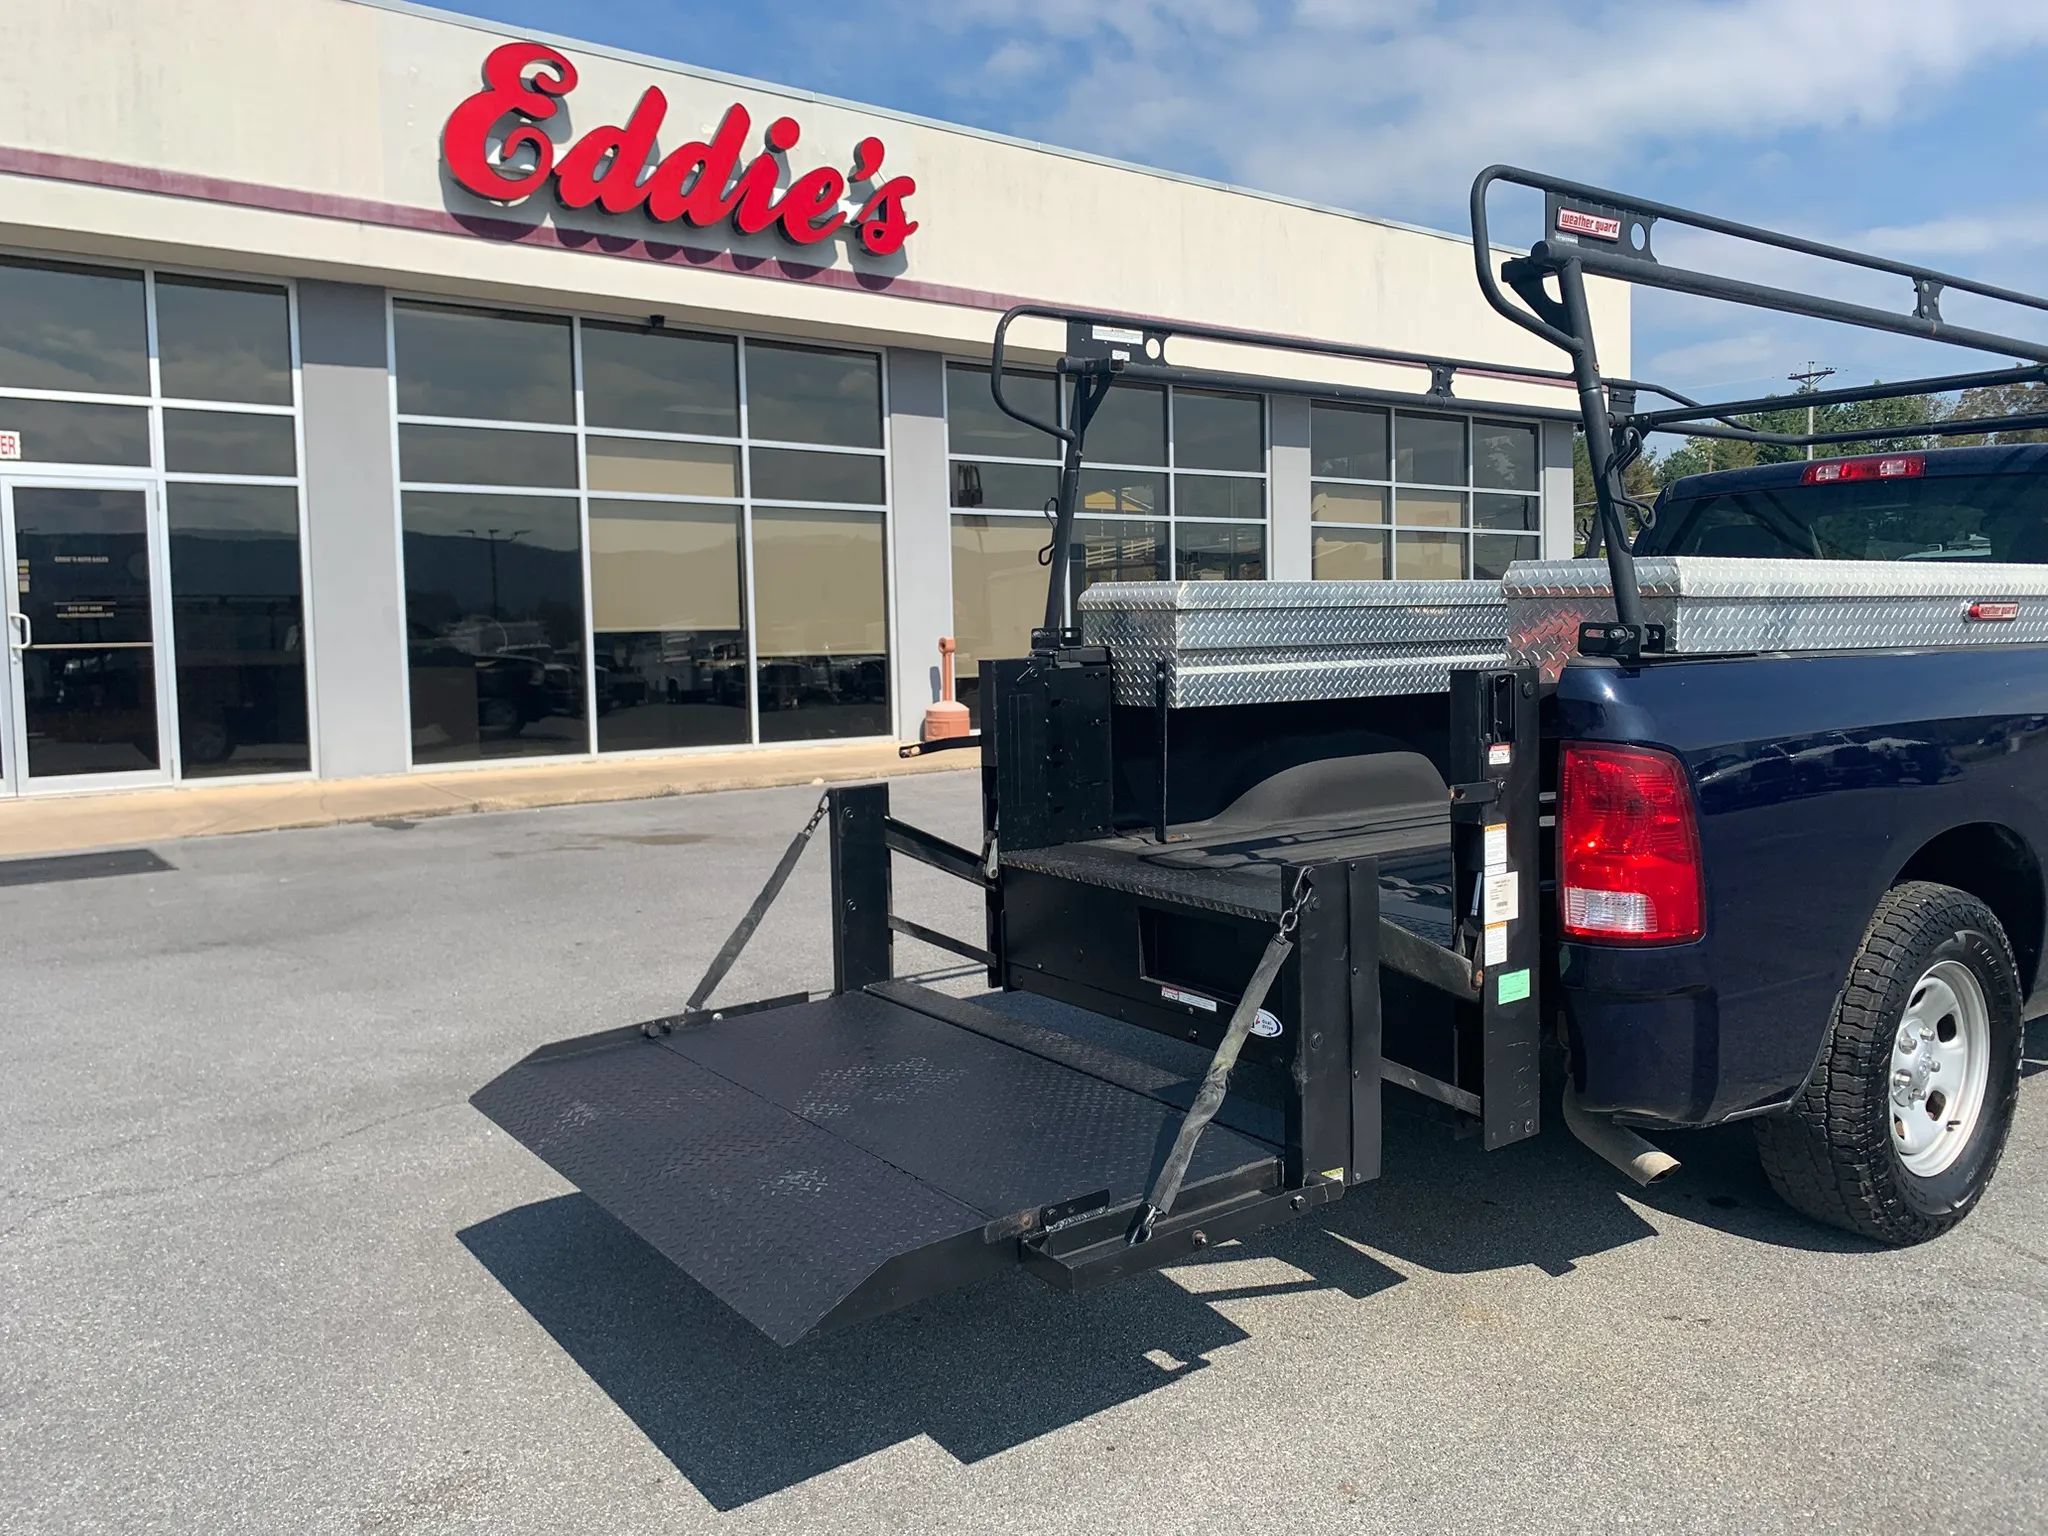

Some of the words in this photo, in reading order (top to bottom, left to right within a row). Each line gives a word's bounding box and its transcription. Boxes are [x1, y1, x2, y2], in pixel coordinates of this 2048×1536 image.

[443, 42, 919, 256] Eddie's
[1561, 213, 1594, 228] weather
[1595, 220, 1618, 233] guard
